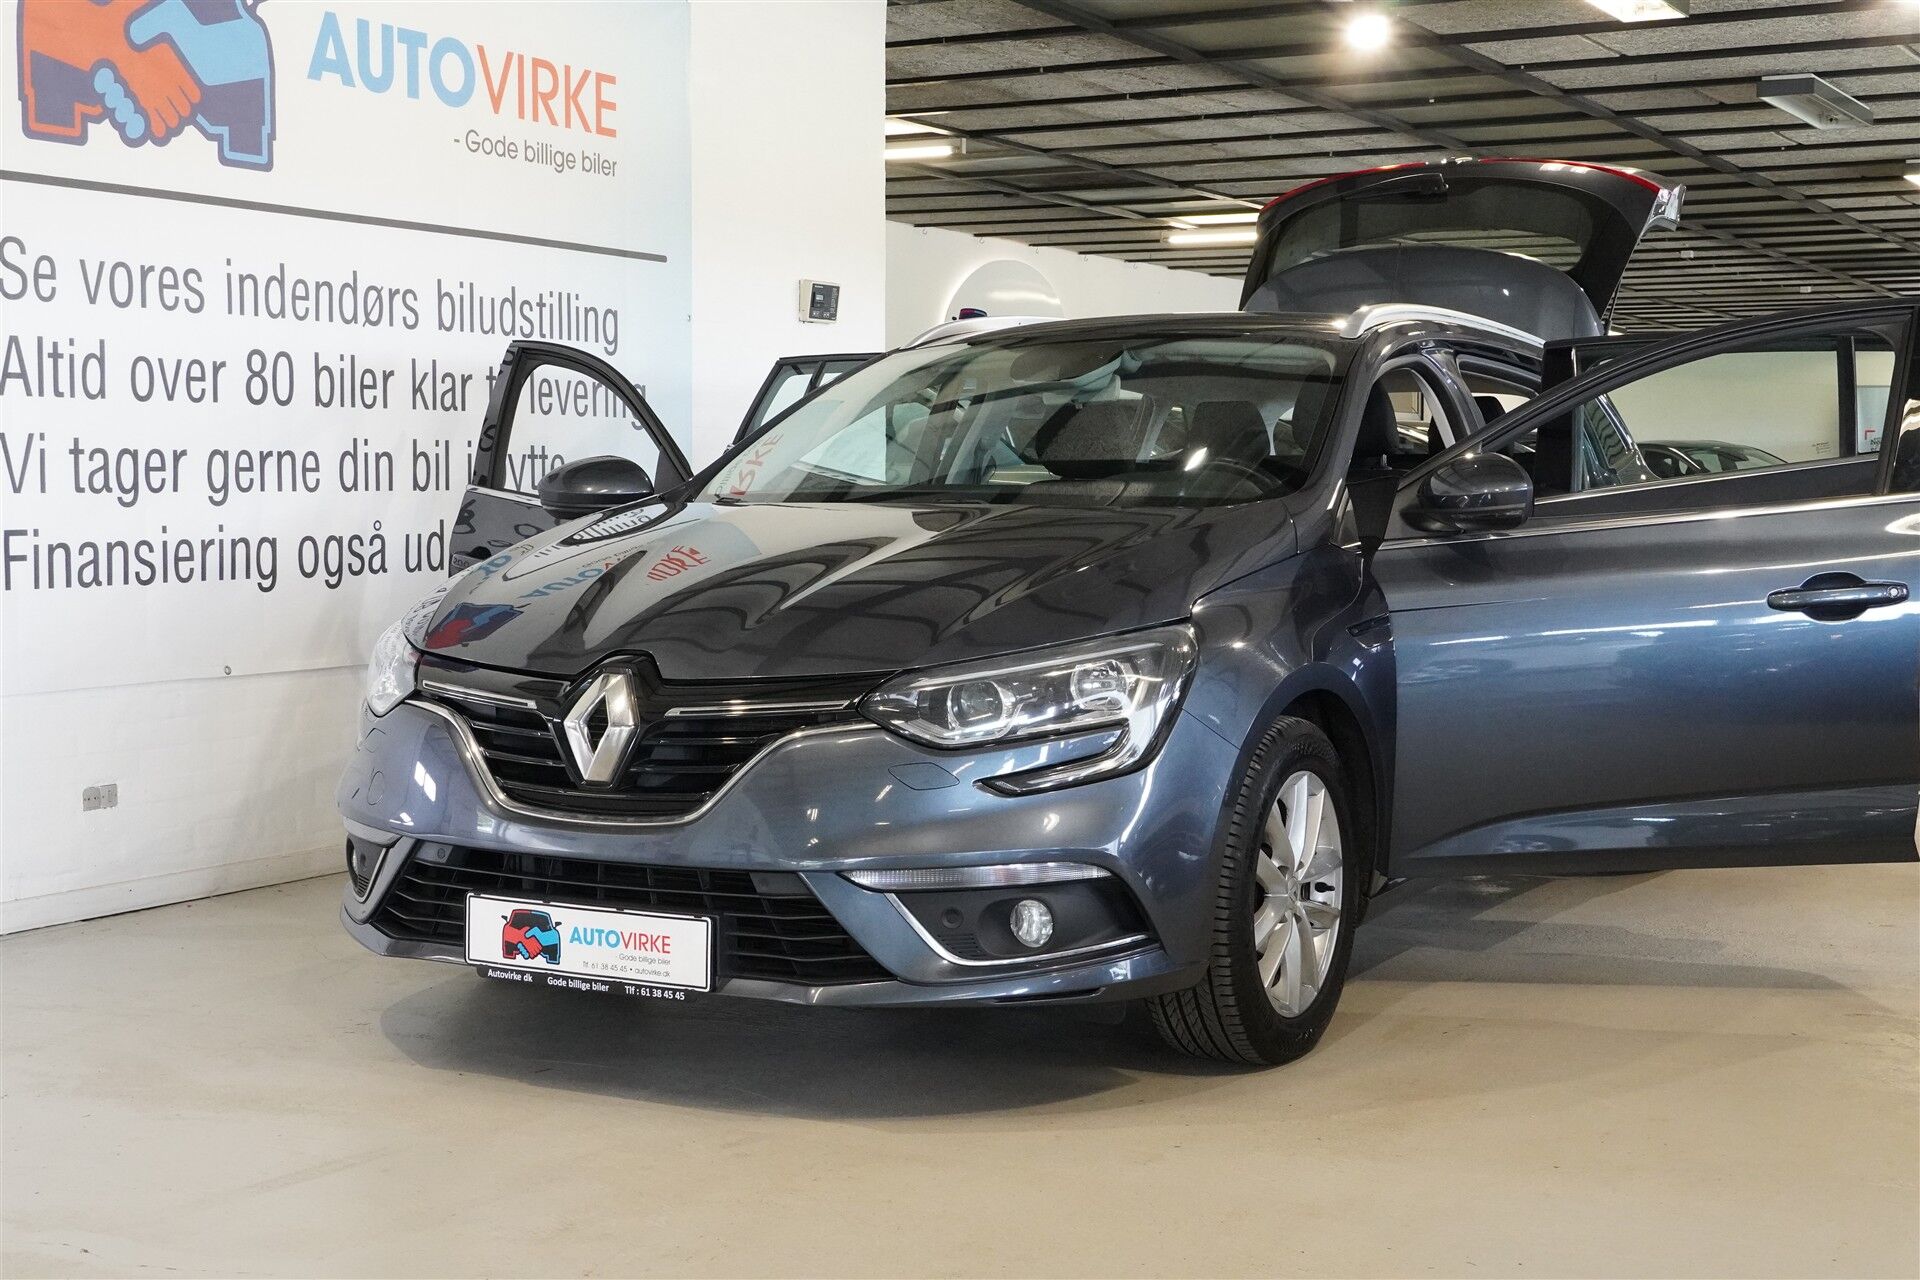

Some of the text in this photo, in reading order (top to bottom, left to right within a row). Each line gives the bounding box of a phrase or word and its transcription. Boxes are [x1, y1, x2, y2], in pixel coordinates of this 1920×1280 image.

[308, 12, 617, 138] AUTOVIRKE
[465, 129, 518, 160] Gode
[524, 140, 577, 174] billige
[581, 149, 618, 178] biler
[0, 236, 619, 357] Se vores indendørs biludstilling
[0, 335, 106, 400] Altid
[130, 355, 227, 404] over
[245, 348, 295, 407] 80
[313, 351, 395, 411] biler
[411, 357, 474, 413] klar
[0, 432, 47, 494] Vi
[68, 437, 188, 508] tager
[206, 448, 321, 508] gerne
[338, 437, 394, 493] din
[412, 438, 451, 493] bil
[507, 444, 566, 491] ytt
[4, 523, 278, 594] Finansiering
[297, 519, 389, 591] også
[569, 926, 671, 955] AUTOVIRKE
[601, 963, 609, 971] 38
[610, 964, 618, 972] 45
[619, 965, 628, 973] 45
[547, 977, 567, 987] Gode
[568, 979, 591, 991] billige
[592, 982, 609, 992] biler
[640, 987, 650, 997] 61
[651, 988, 662, 998] 38
[663, 990, 673, 999] 45
[674, 992, 685, 1000] 45
